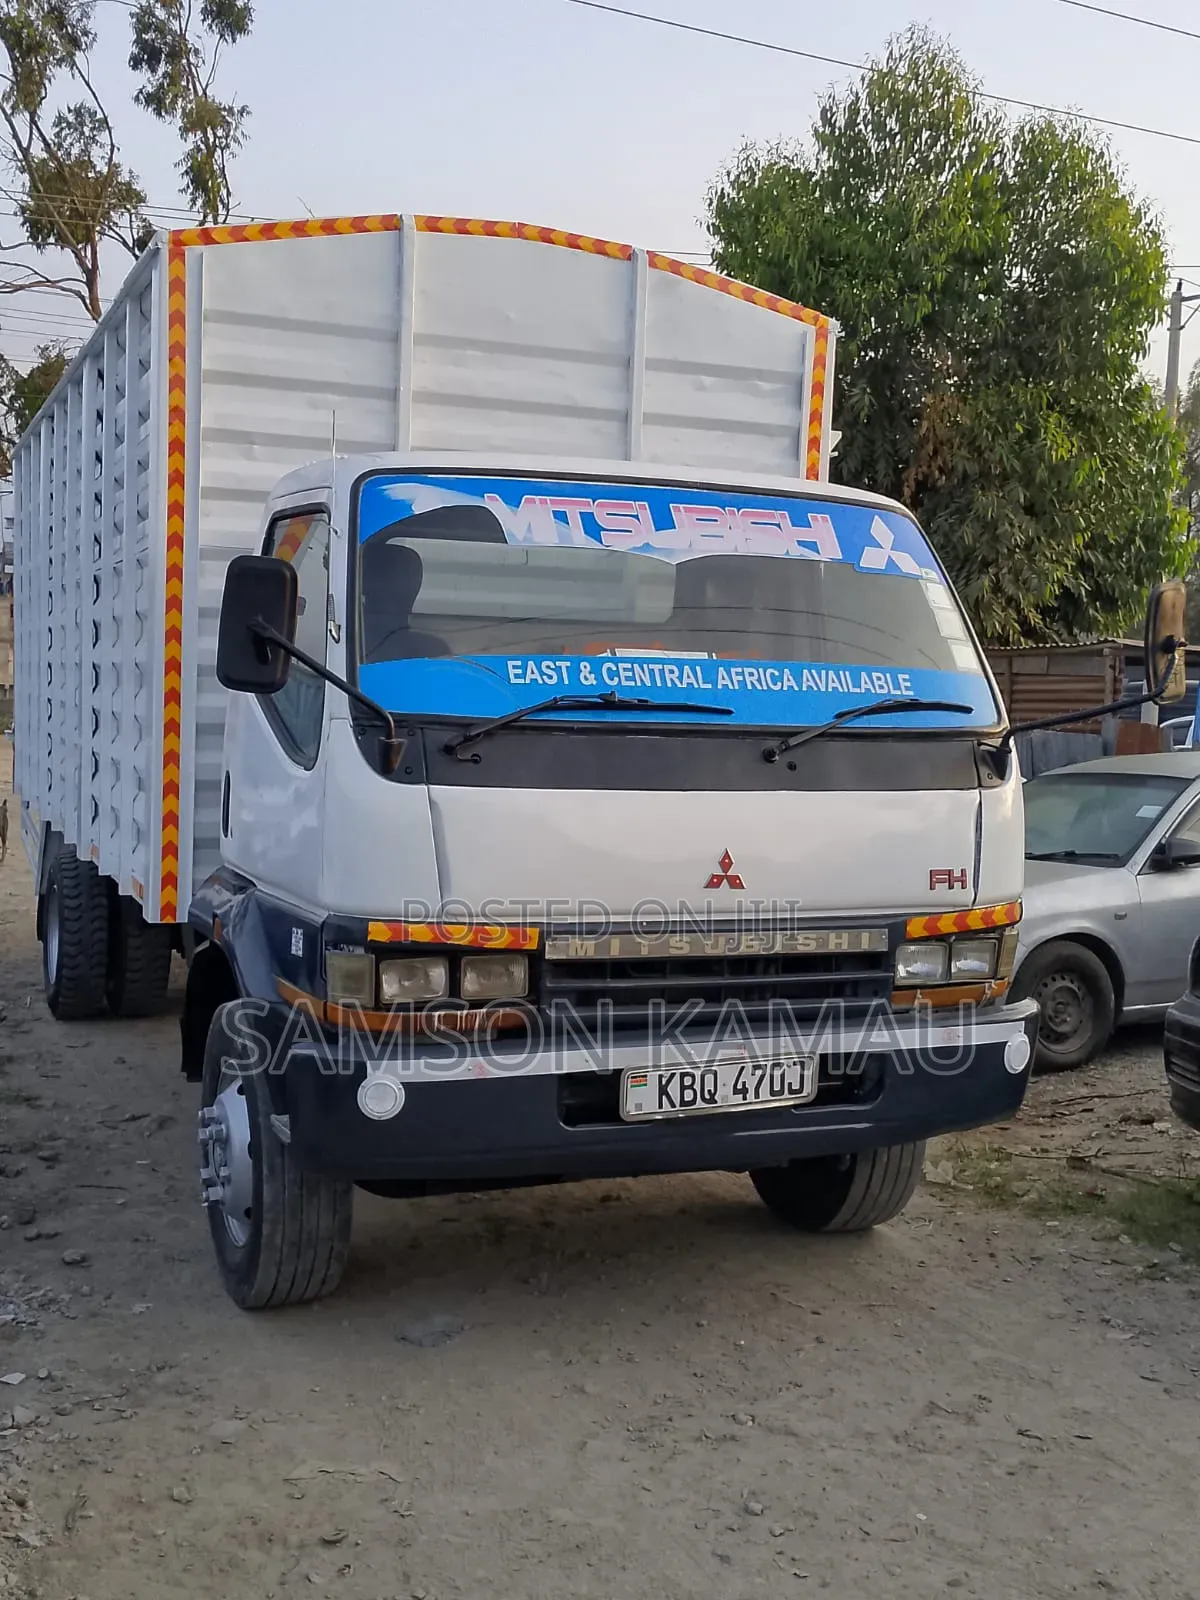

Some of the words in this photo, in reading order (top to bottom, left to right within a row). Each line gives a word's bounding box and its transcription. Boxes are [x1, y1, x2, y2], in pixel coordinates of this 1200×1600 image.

[507, 660, 571, 685] EAST
[578, 662, 597, 686] &
[602, 663, 712, 690] CENTRAL
[717, 667, 798, 692] AFRICA
[802, 669, 914, 696] AVAILABLE
[929, 868, 967, 890] FH
[568, 932, 871, 957] MITSUBISHI
[657, 1068, 719, 1110] KBQ
[732, 1059, 806, 1101] 470J
